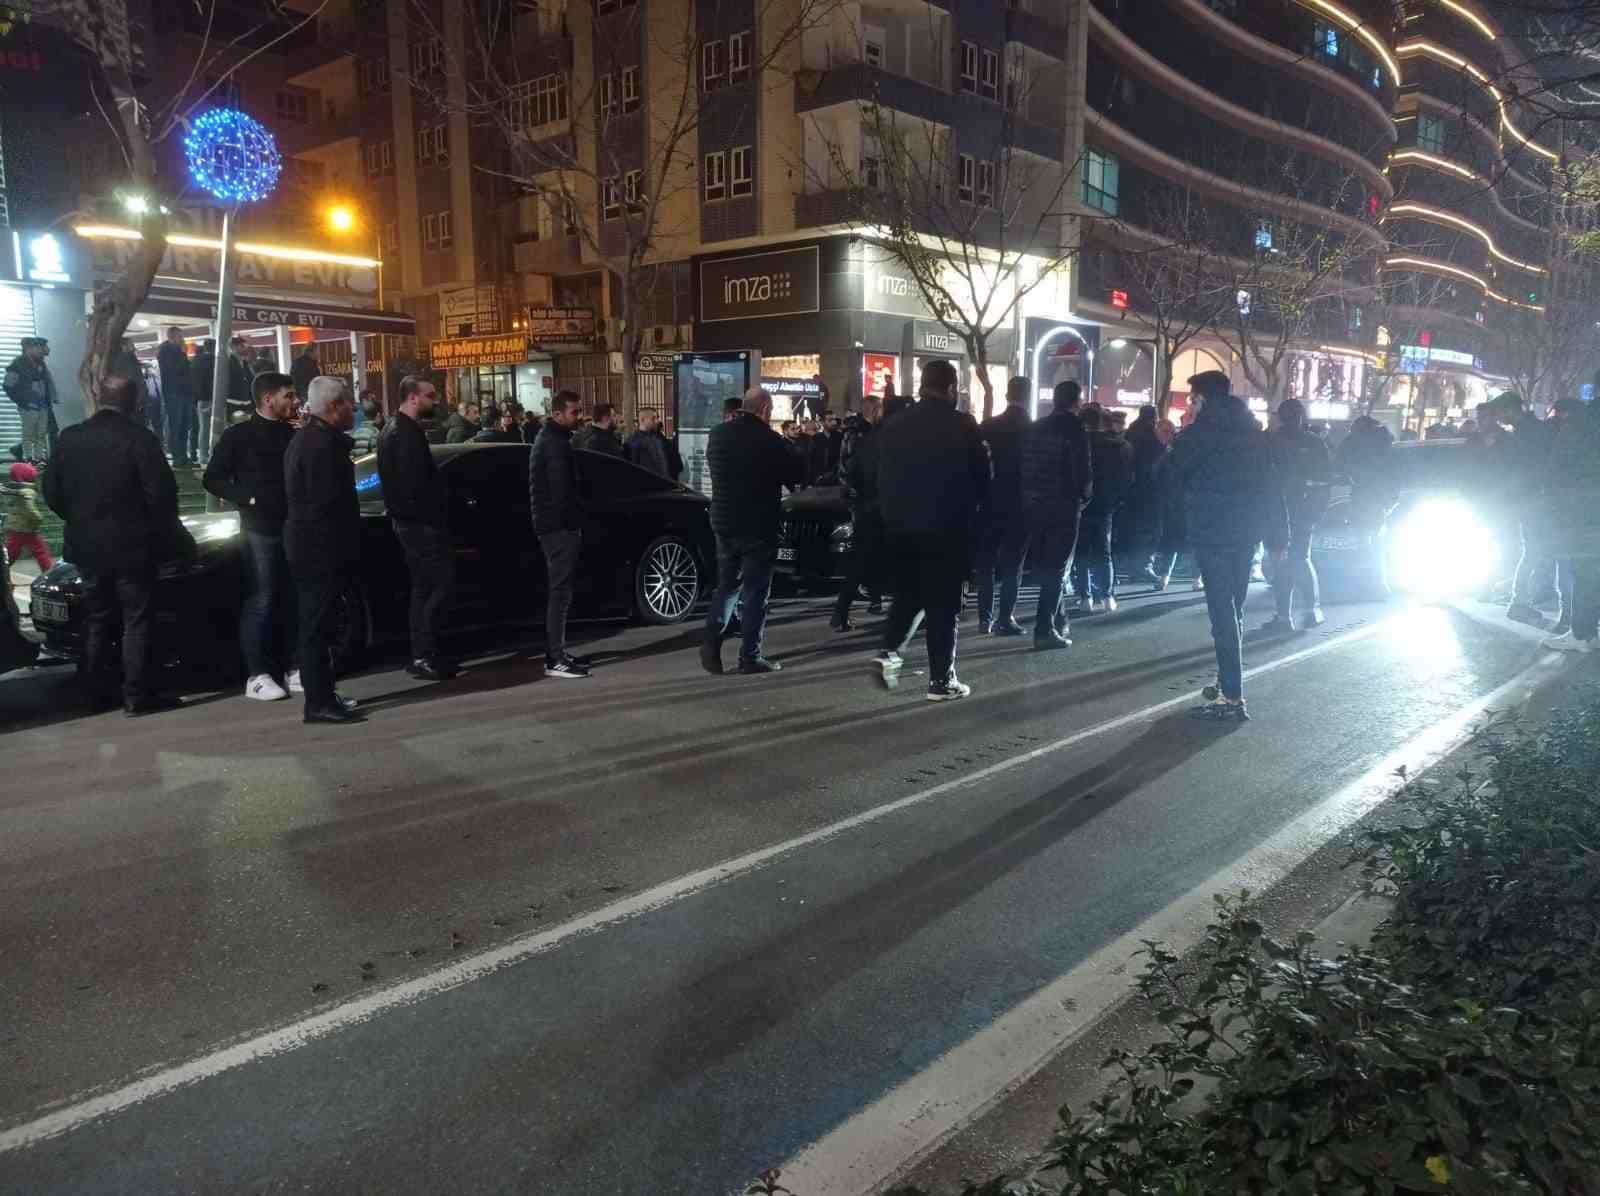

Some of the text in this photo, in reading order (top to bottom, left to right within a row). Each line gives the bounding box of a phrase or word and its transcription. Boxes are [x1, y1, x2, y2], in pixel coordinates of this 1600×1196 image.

[724, 275, 771, 304] imza
[878, 272, 907, 297] imza
[926, 332, 949, 349] imza
